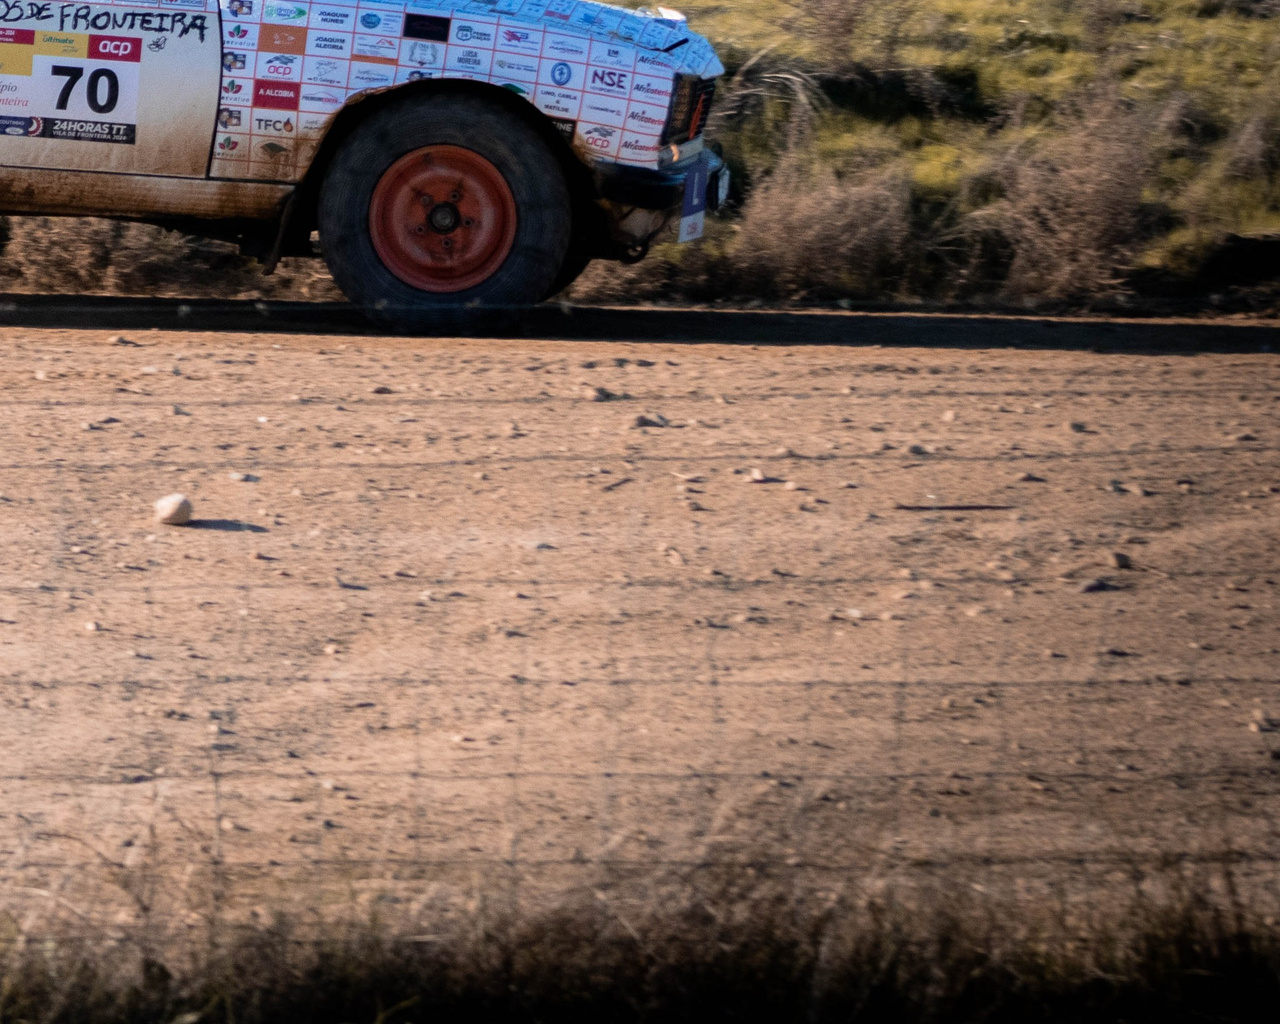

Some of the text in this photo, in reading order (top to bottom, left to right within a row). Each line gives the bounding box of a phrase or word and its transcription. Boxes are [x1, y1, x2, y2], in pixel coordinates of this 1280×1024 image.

[318, 10, 349, 18] JOAQUIM
[23, 2, 54, 20] DE
[56, 3, 208, 43] FRONTEIRA
[315, 36, 346, 44] JOAQUIM
[98, 40, 132, 56] acp
[314, 43, 344, 51] ALEGRIA
[267, 64, 292, 76] acp
[592, 70, 627, 89] NSE
[51, 64, 120, 114] 70
[266, 90, 294, 98] ALCOBIA
[557, 92, 577, 100] CARLA
[53, 120, 127, 134] 24HORAS TT
[256, 118, 282, 132] TFC
[76, 132, 111, 140] FRONTEIRA
[586, 136, 610, 148] acp
